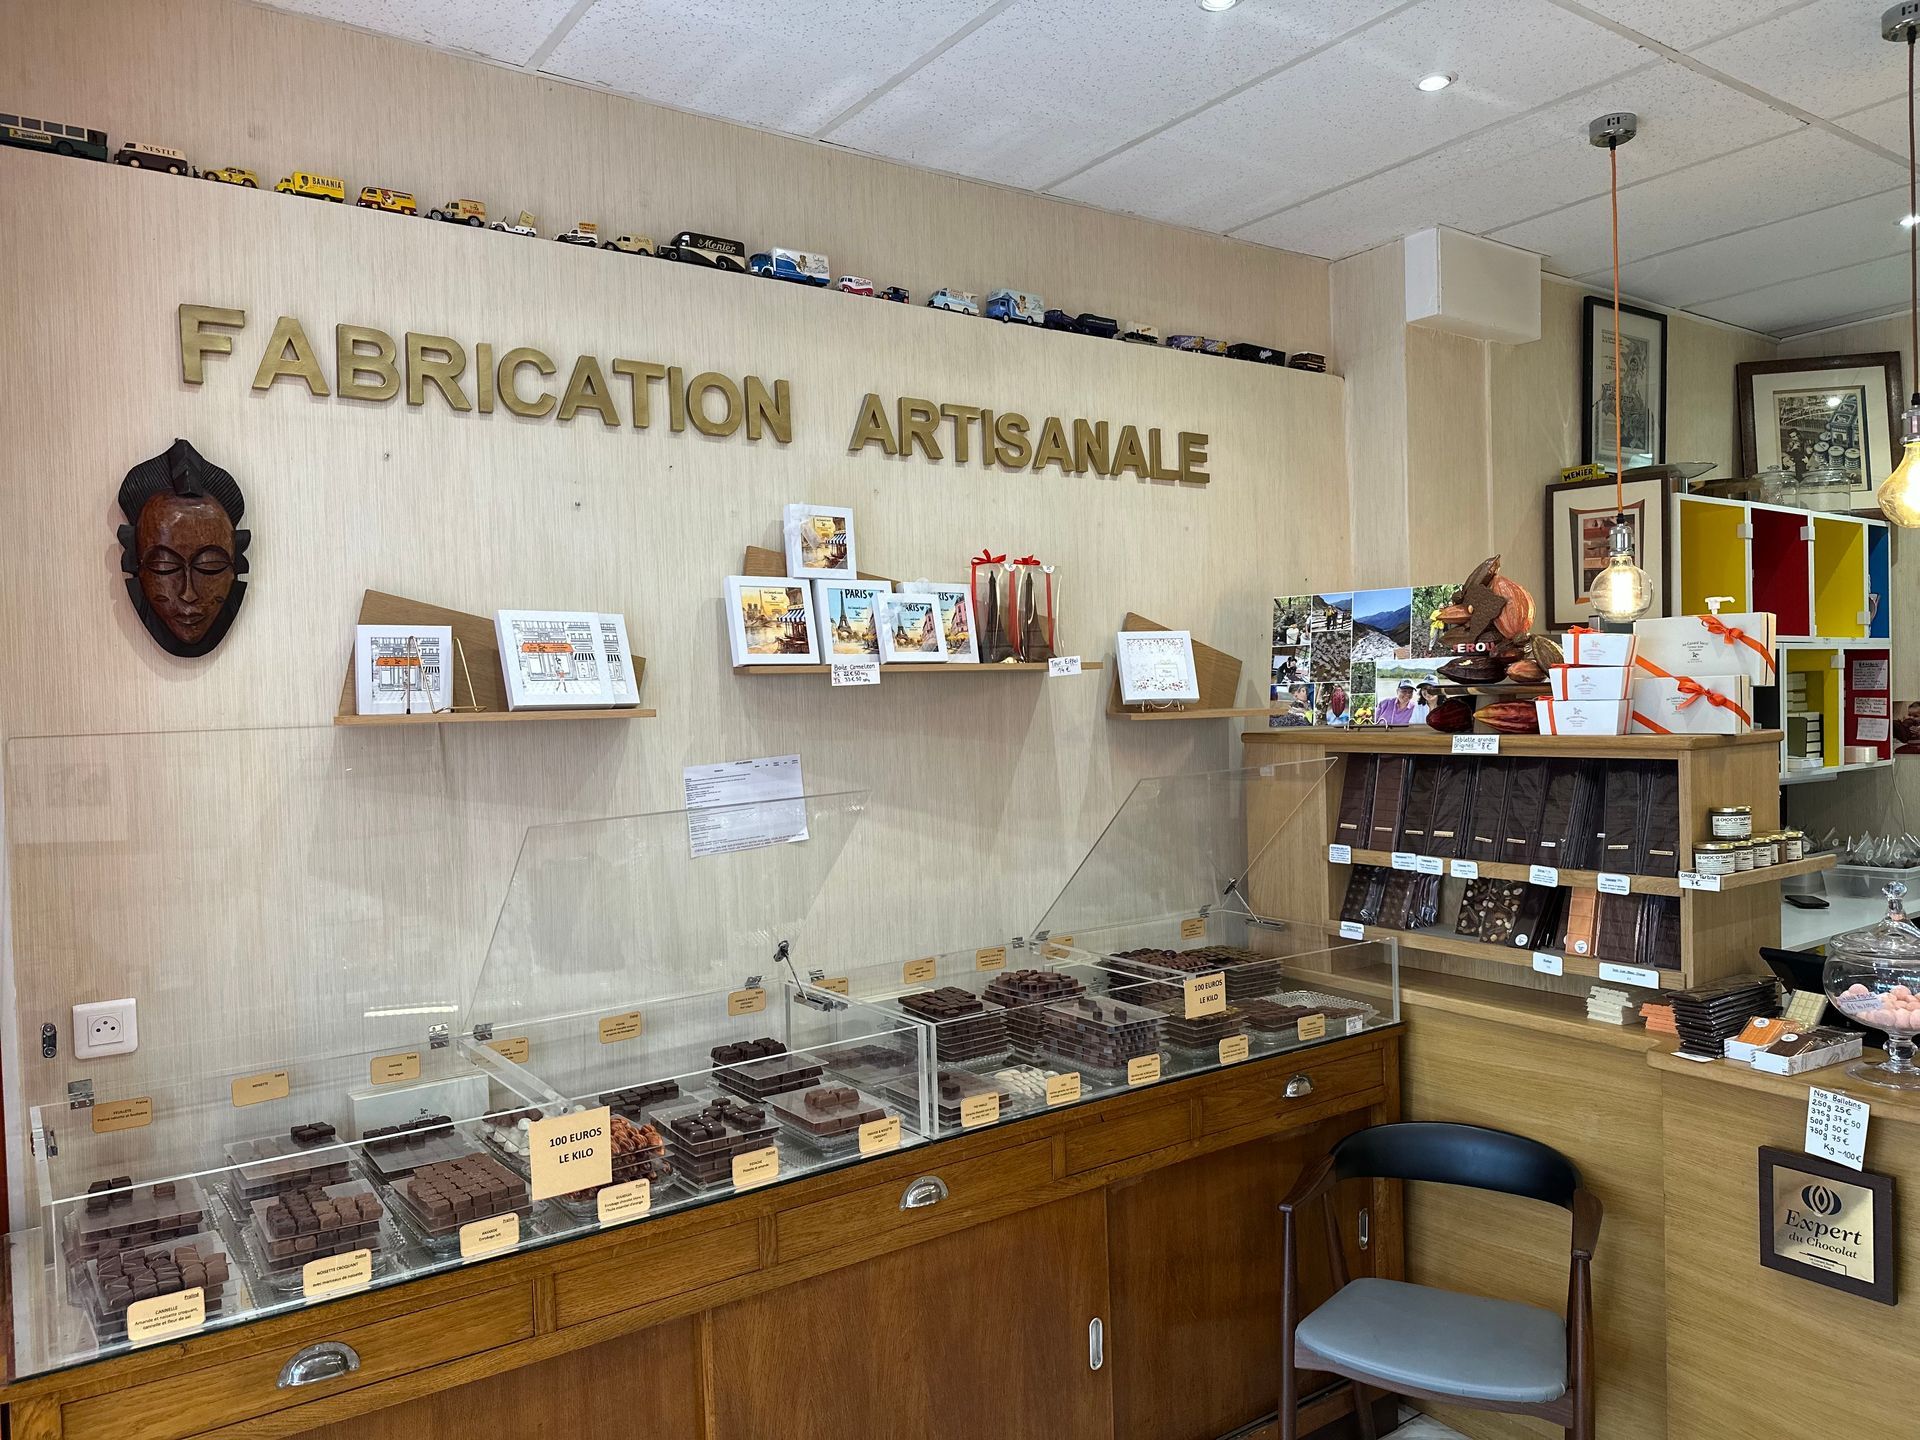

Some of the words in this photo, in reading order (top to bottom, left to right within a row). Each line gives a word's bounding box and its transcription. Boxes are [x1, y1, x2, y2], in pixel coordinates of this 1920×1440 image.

[312, 176, 342, 190] BANANIA
[697, 239, 736, 254] Menier
[179, 303, 792, 443] FABRICATION
[848, 393, 1210, 484] ARTISANALE
[1563, 468, 1593, 481] MENiER
[845, 588, 868, 599] PARIS
[1205, 979, 1223, 990] EUROS
[1199, 996, 1206, 1004] LE
[1206, 993, 1219, 1002] KILO
[1814, 1090, 1828, 1099] Nos
[1833, 1095, 1861, 1110] Ballotins
[549, 1135, 568, 1148] 100
[569, 1127, 602, 1143] EUROS
[558, 1153, 570, 1164] LE
[572, 1147, 594, 1161] KILO
[1785, 1208, 1862, 1245] Expert
[1788, 1232, 1803, 1243] du
[1806, 1236, 1858, 1259] Chocolat
[317, 1267, 336, 1276] NOISETTE
[336, 1261, 359, 1271] CROQUANT
[183, 1292, 200, 1300] Praliné
[155, 1305, 178, 1315] CANNELLE
[160, 1312, 178, 1320] noisette
[178, 1306, 199, 1316] croquant,
[142, 1322, 161, 1330] cannelle
